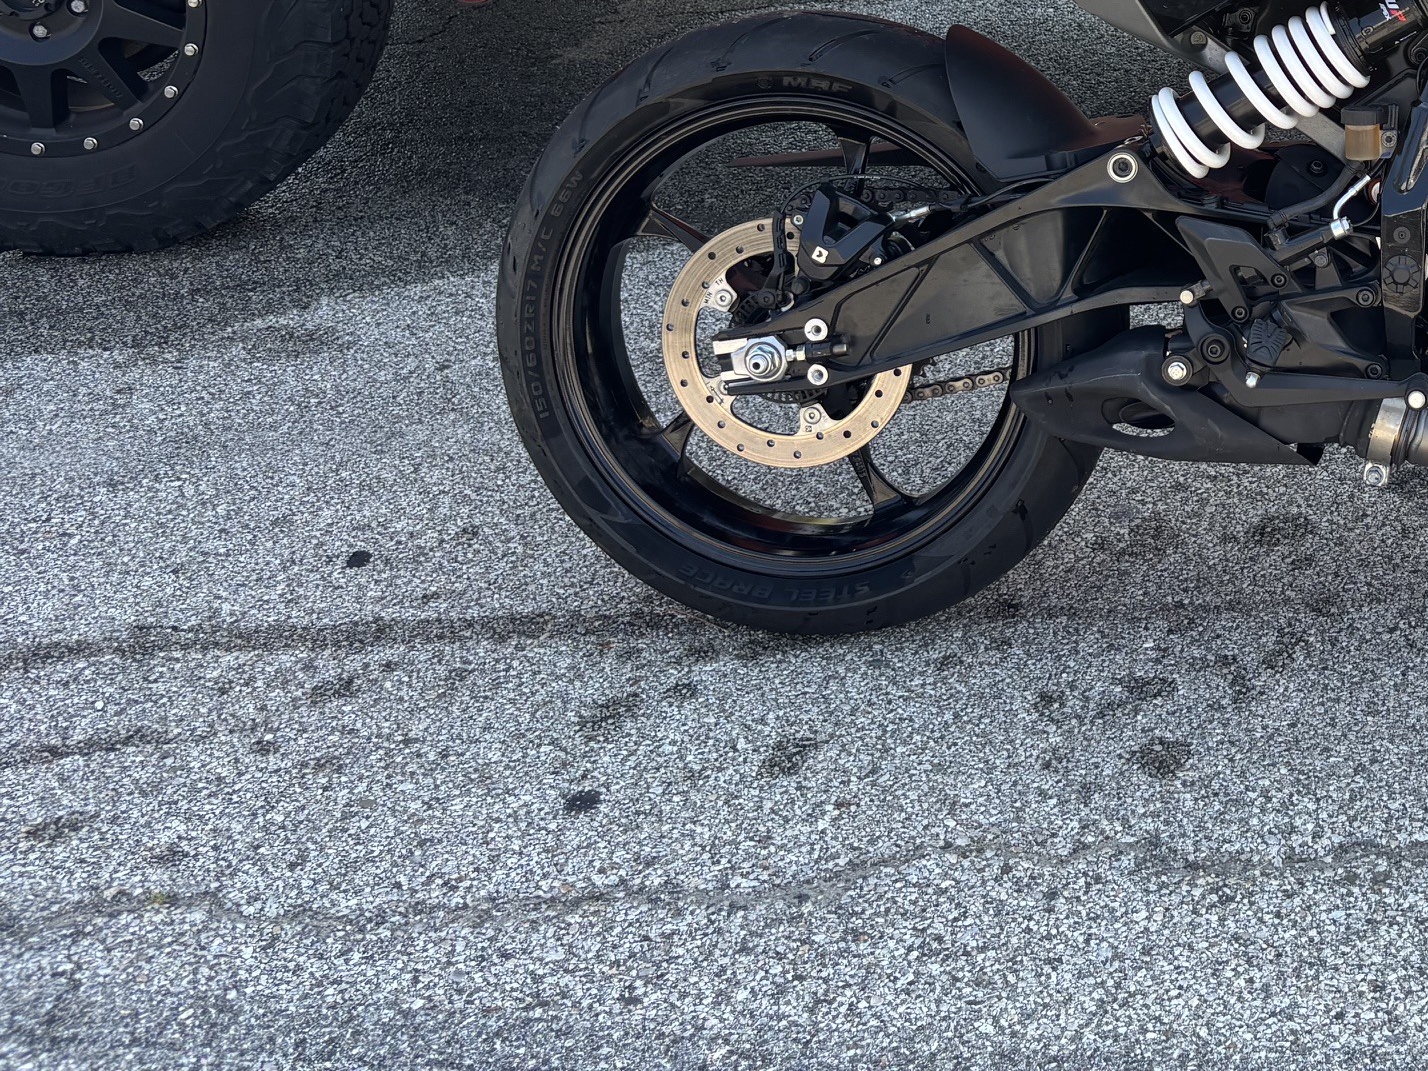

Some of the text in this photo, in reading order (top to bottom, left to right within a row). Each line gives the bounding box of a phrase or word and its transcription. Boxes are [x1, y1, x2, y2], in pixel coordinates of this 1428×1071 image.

[781, 75, 853, 95] MRF
[550, 168, 586, 220] 66W
[703, 291, 714, 304] MIN
